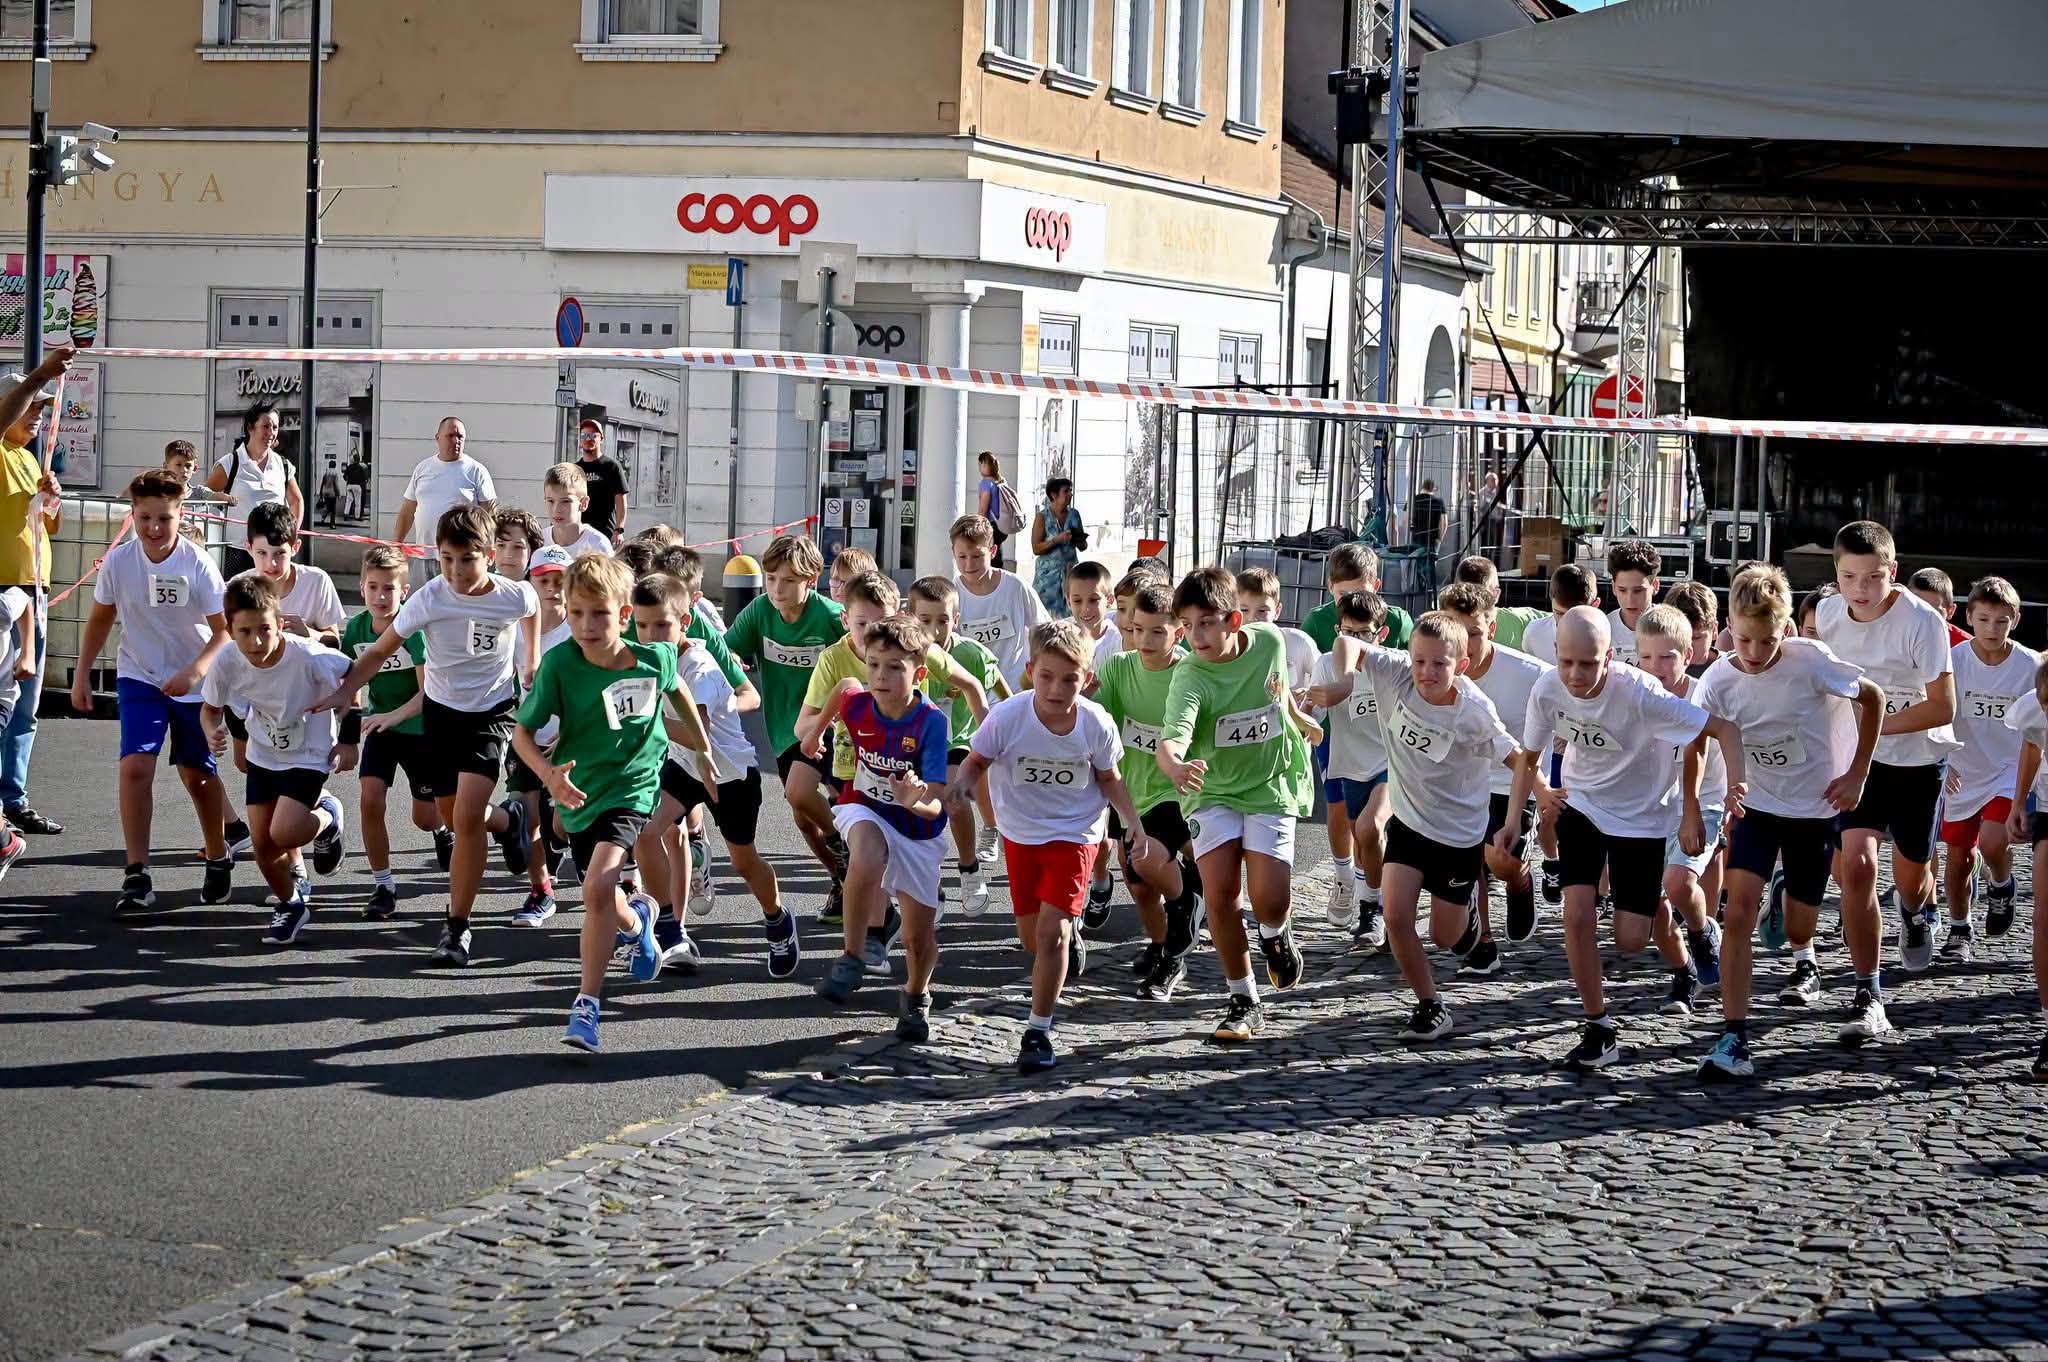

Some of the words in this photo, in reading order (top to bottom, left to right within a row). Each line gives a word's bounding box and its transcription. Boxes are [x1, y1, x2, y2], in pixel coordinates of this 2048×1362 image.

[677, 192, 819, 246] coop
[1025, 206, 1072, 262] coop
[853, 323, 905, 354] oop
[472, 631, 496, 650] 53
[974, 627, 1000, 643] 219
[777, 653, 812, 667] 945
[1974, 701, 2006, 719] 313
[1228, 721, 1269, 743] 449
[1400, 725, 1432, 754] 152
[1570, 727, 1605, 747] 716
[1132, 735, 1157, 752] 44
[858, 745, 914, 771] Rakuten
[1751, 750, 1788, 766] 155
[1024, 767, 1074, 785] 320
[866, 786, 895, 803] 45
